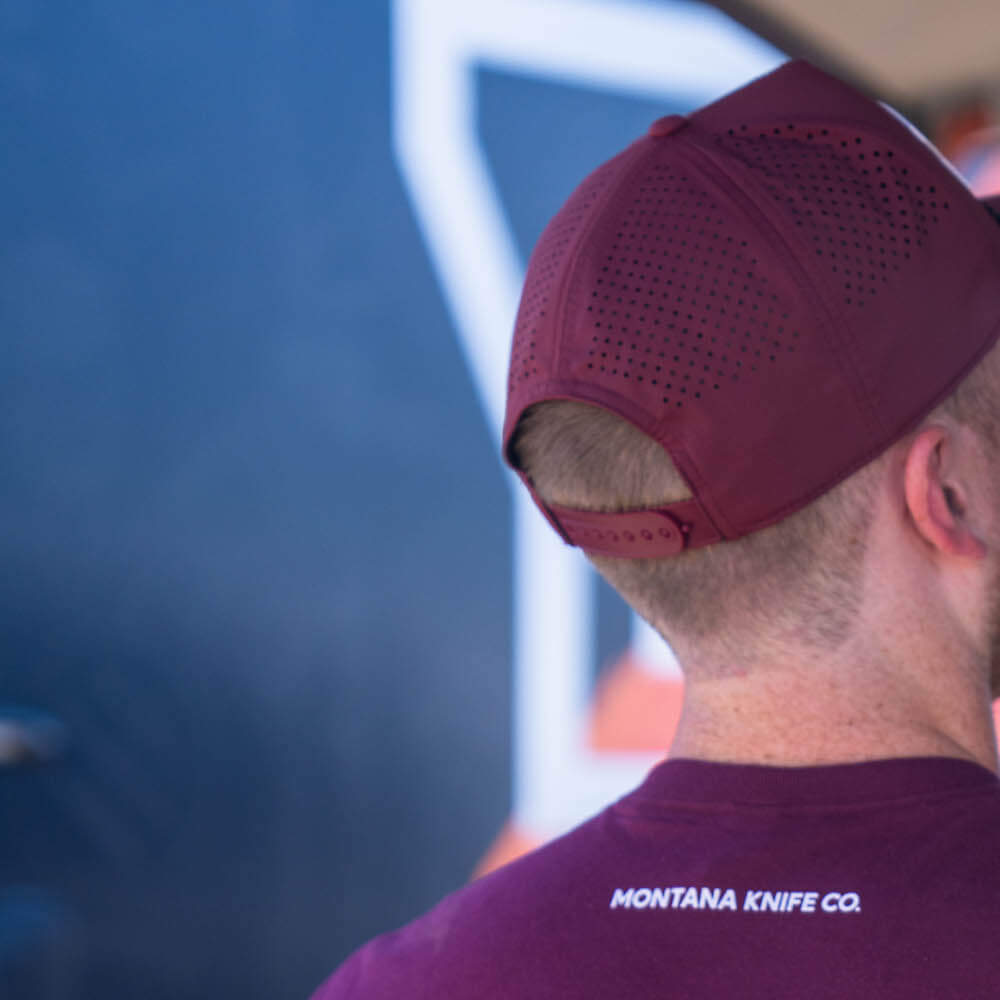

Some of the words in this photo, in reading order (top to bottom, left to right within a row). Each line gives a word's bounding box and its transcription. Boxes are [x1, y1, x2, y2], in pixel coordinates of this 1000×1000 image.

[610, 887, 738, 911] MONTANA
[743, 890, 819, 913] KNIFE
[820, 892, 862, 913] CO.
